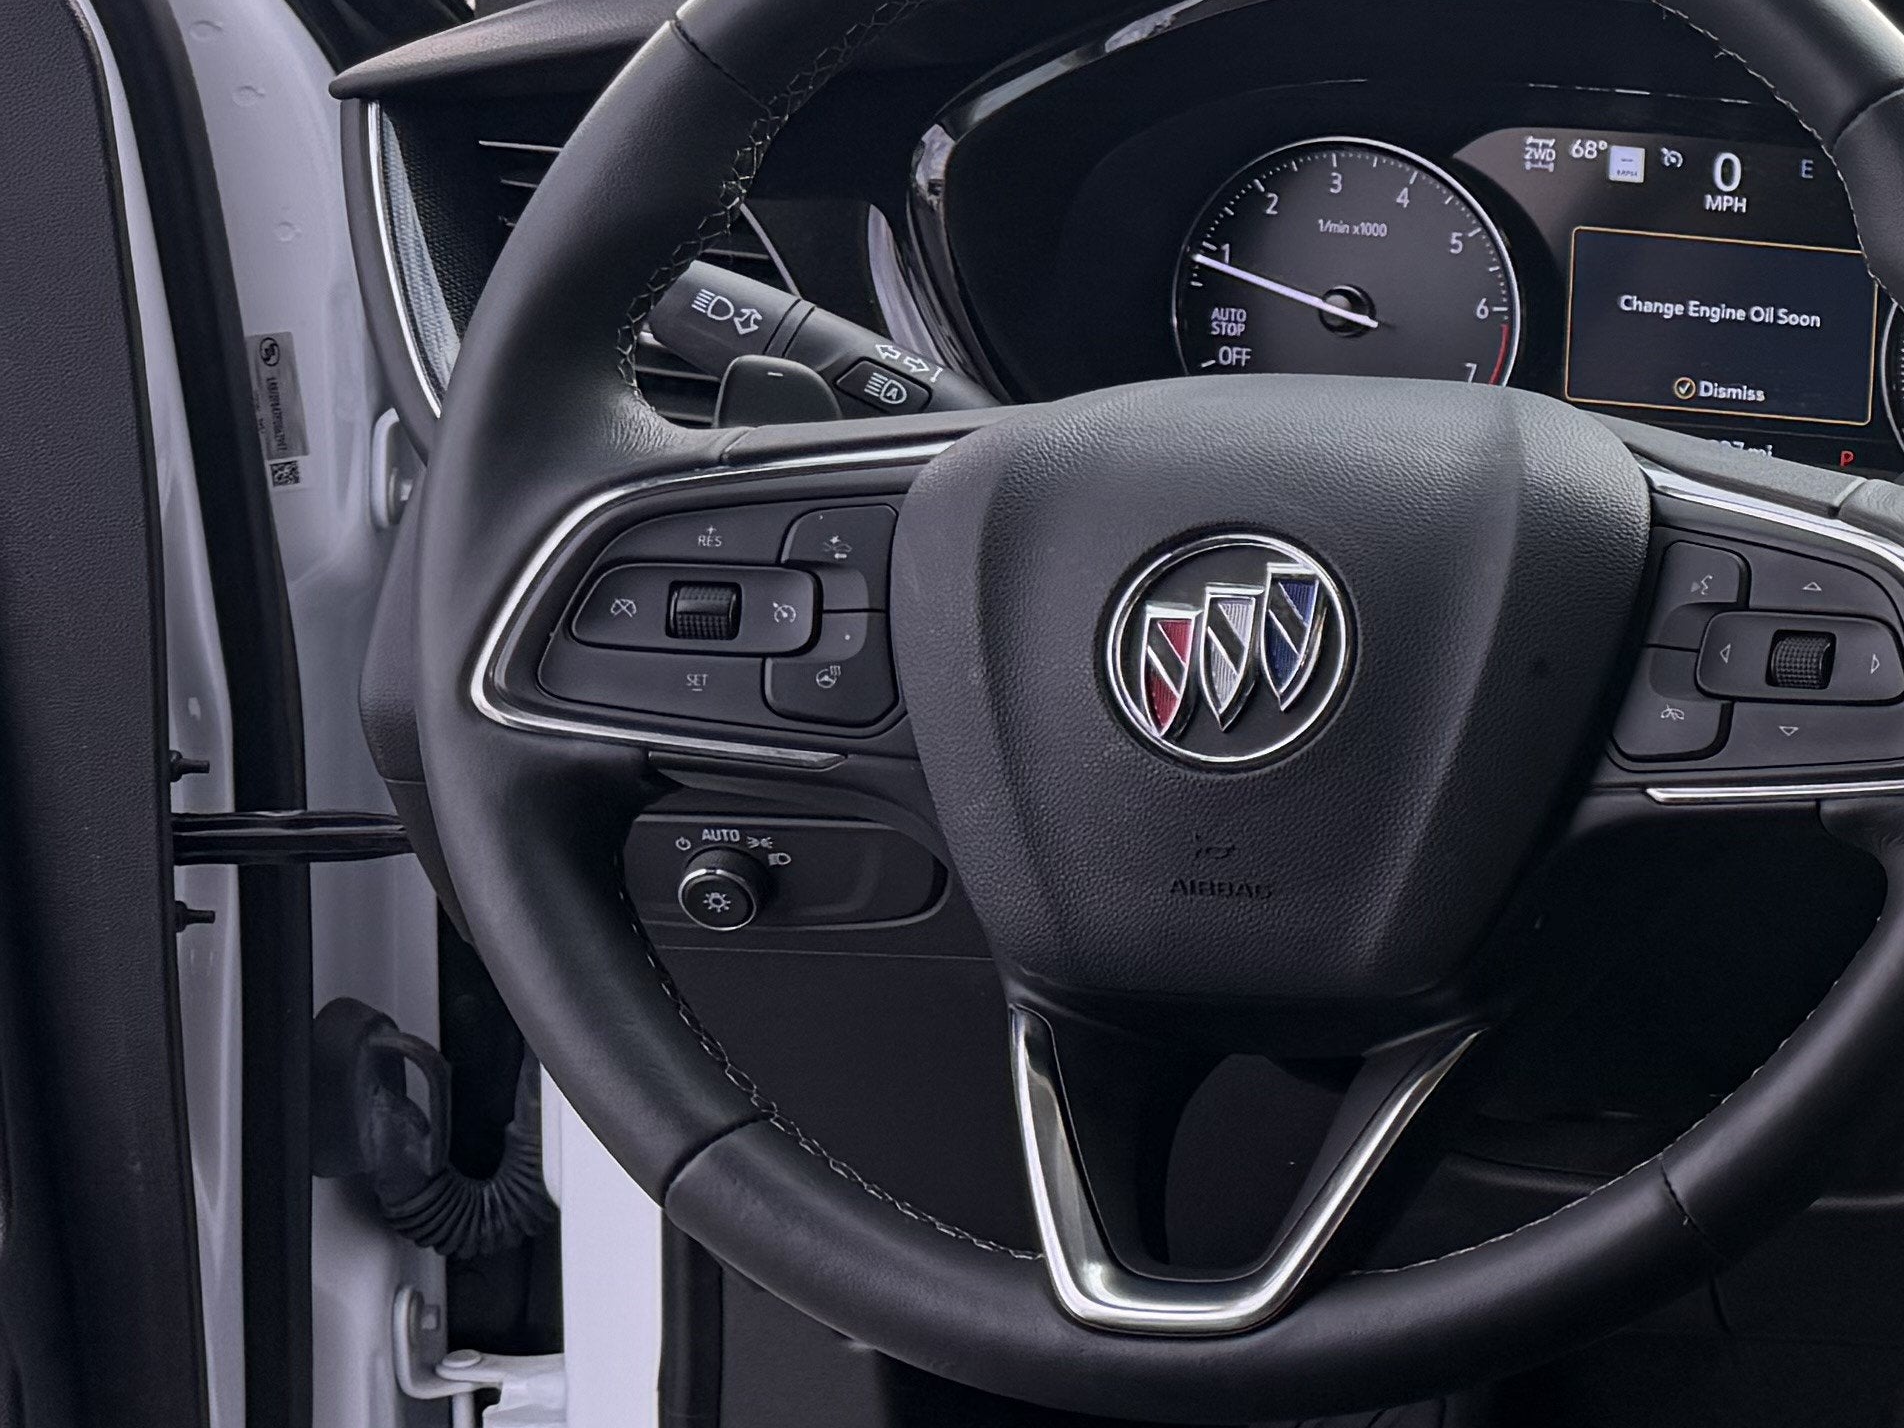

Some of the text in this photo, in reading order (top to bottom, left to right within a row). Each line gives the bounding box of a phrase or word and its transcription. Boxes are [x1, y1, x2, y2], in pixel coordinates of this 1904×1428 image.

[1523, 146, 1557, 163] 2WD
[1569, 138, 1608, 160] 68°
[1713, 152, 1743, 192] 0
[1800, 158, 1815, 180] E
[1329, 172, 1343, 194] 3
[1264, 194, 1279, 216] 2
[1396, 188, 1410, 209] 4
[1703, 194, 1748, 214] MPH
[1317, 218, 1388, 238] 1/min x1000
[1219, 242, 1232, 263] 1
[1449, 232, 1464, 254] 5
[1210, 307, 1248, 323] AUTO
[1476, 298, 1490, 320] 6
[1618, 294, 1821, 329] Change Engine Oil Soon
[1210, 321, 1246, 337] STOP
[1218, 346, 1252, 367] OFF
[1465, 363, 1478, 385] 7
[1699, 379, 1766, 403] Dismiss
[1839, 449, 1854, 467] P
[697, 533, 723, 549] RES
[685, 673, 709, 688] SET
[701, 828, 741, 843] AUTO
[1169, 877, 1274, 900] AIRBAG
